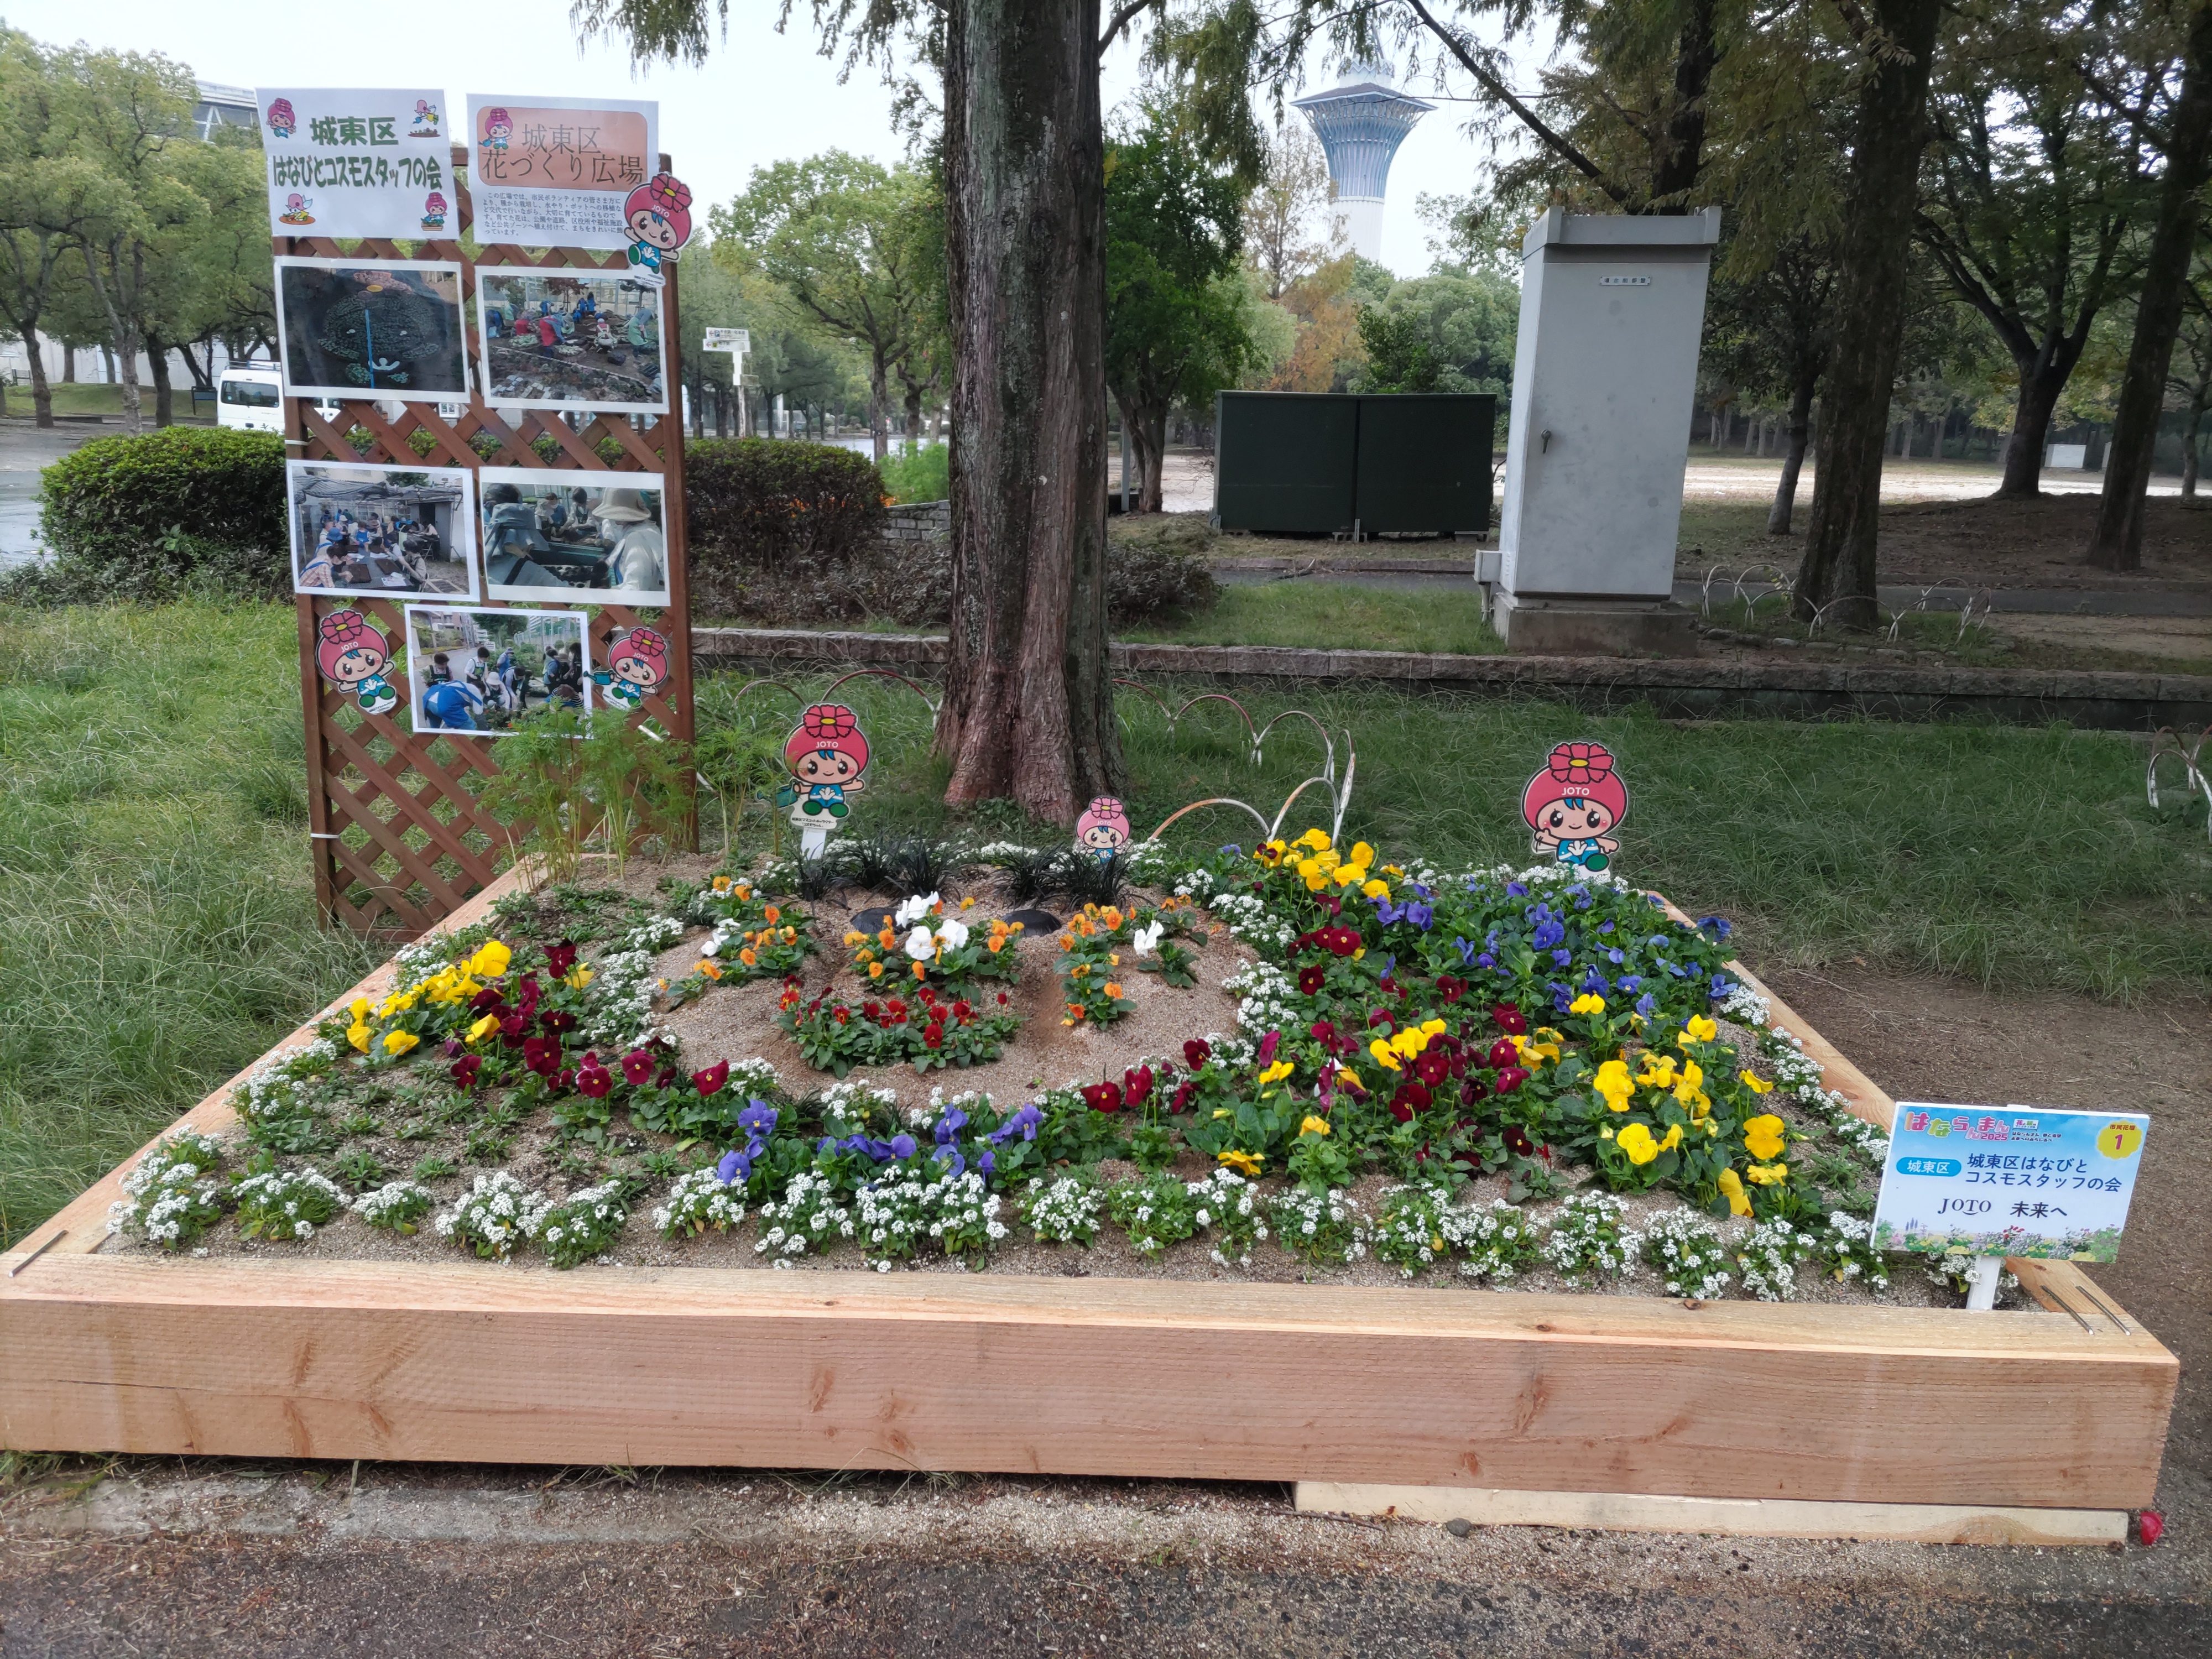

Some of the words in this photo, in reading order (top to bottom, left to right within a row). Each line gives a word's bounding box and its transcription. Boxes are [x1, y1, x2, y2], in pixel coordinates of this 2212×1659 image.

[310, 116, 399, 145] 城東区
[522, 123, 601, 154] 城東区
[273, 155, 442, 190] はなびとコスモスタッフの会
[482, 149, 643, 184] 花づくり広場
[651, 204, 670, 218] JOTO
[341, 641, 358, 653] JOTO
[633, 652, 649, 662] JOTO
[1562, 787, 1590, 796] JOTO
[1981, 1133, 2008, 1141] 2025
[2115, 1134, 2122, 1150] 1
[1907, 1160, 1950, 1174] 城東区
[1966, 1153, 2088, 1173] 城東区はなびと
[1965, 1171, 2122, 1192] コスモスタッフの会
[1937, 1198, 1991, 1215] JOTO
[2010, 1201, 2067, 1218] 未来へ
